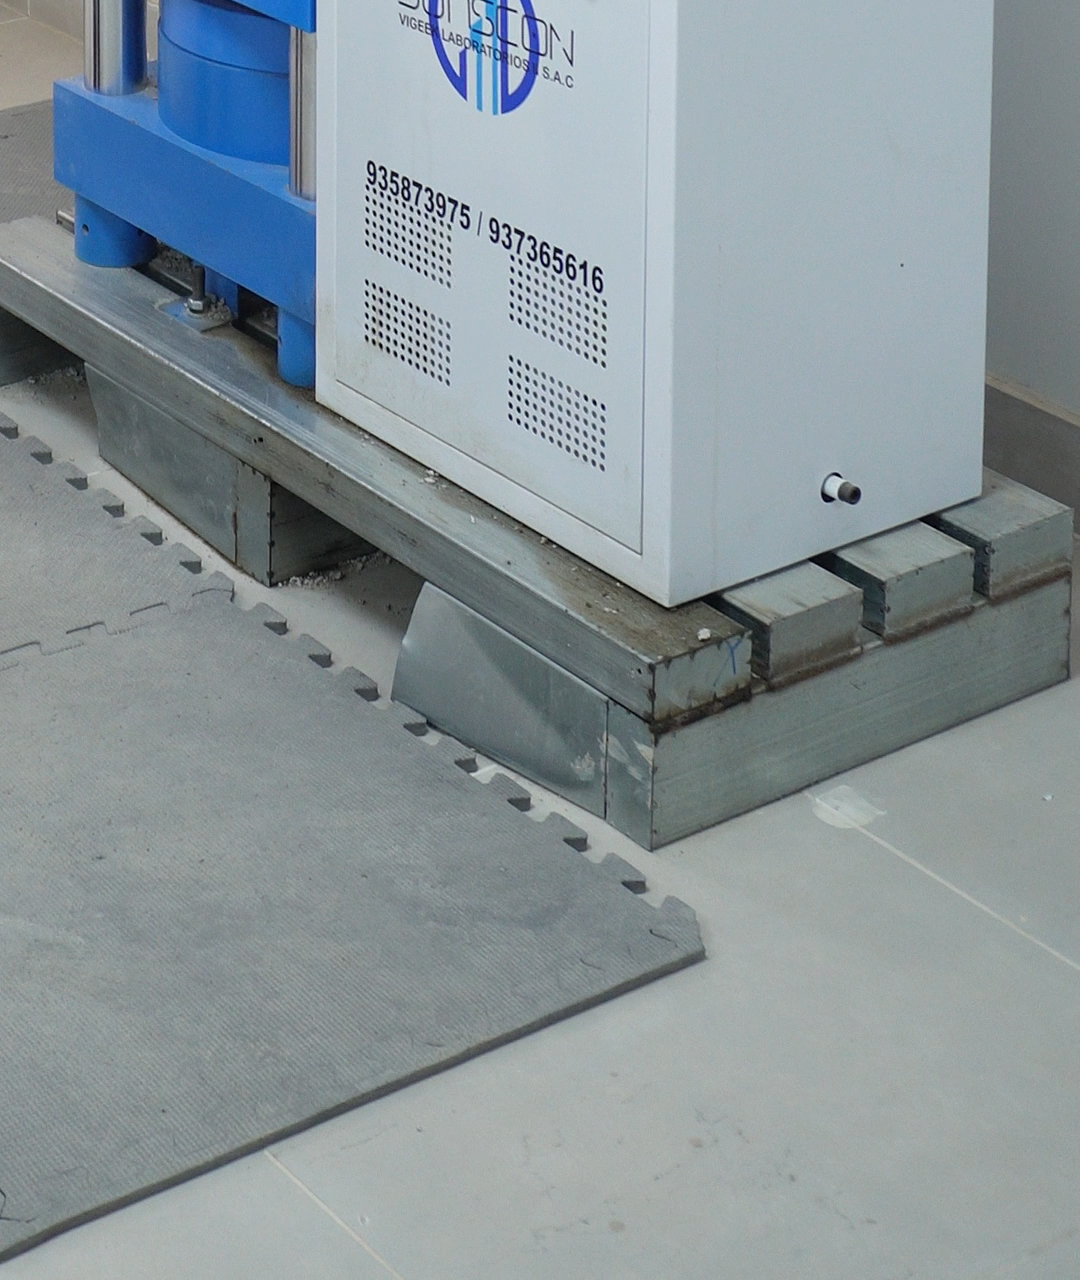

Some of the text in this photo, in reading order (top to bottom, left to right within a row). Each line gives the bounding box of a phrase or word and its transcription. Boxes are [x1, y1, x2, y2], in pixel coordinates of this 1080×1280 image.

[441, 27, 531, 74] LABORATORIOS
[542, 66, 575, 89] S.A.C
[365, 159, 472, 231] 935873975
[488, 217, 604, 295] 937365616
